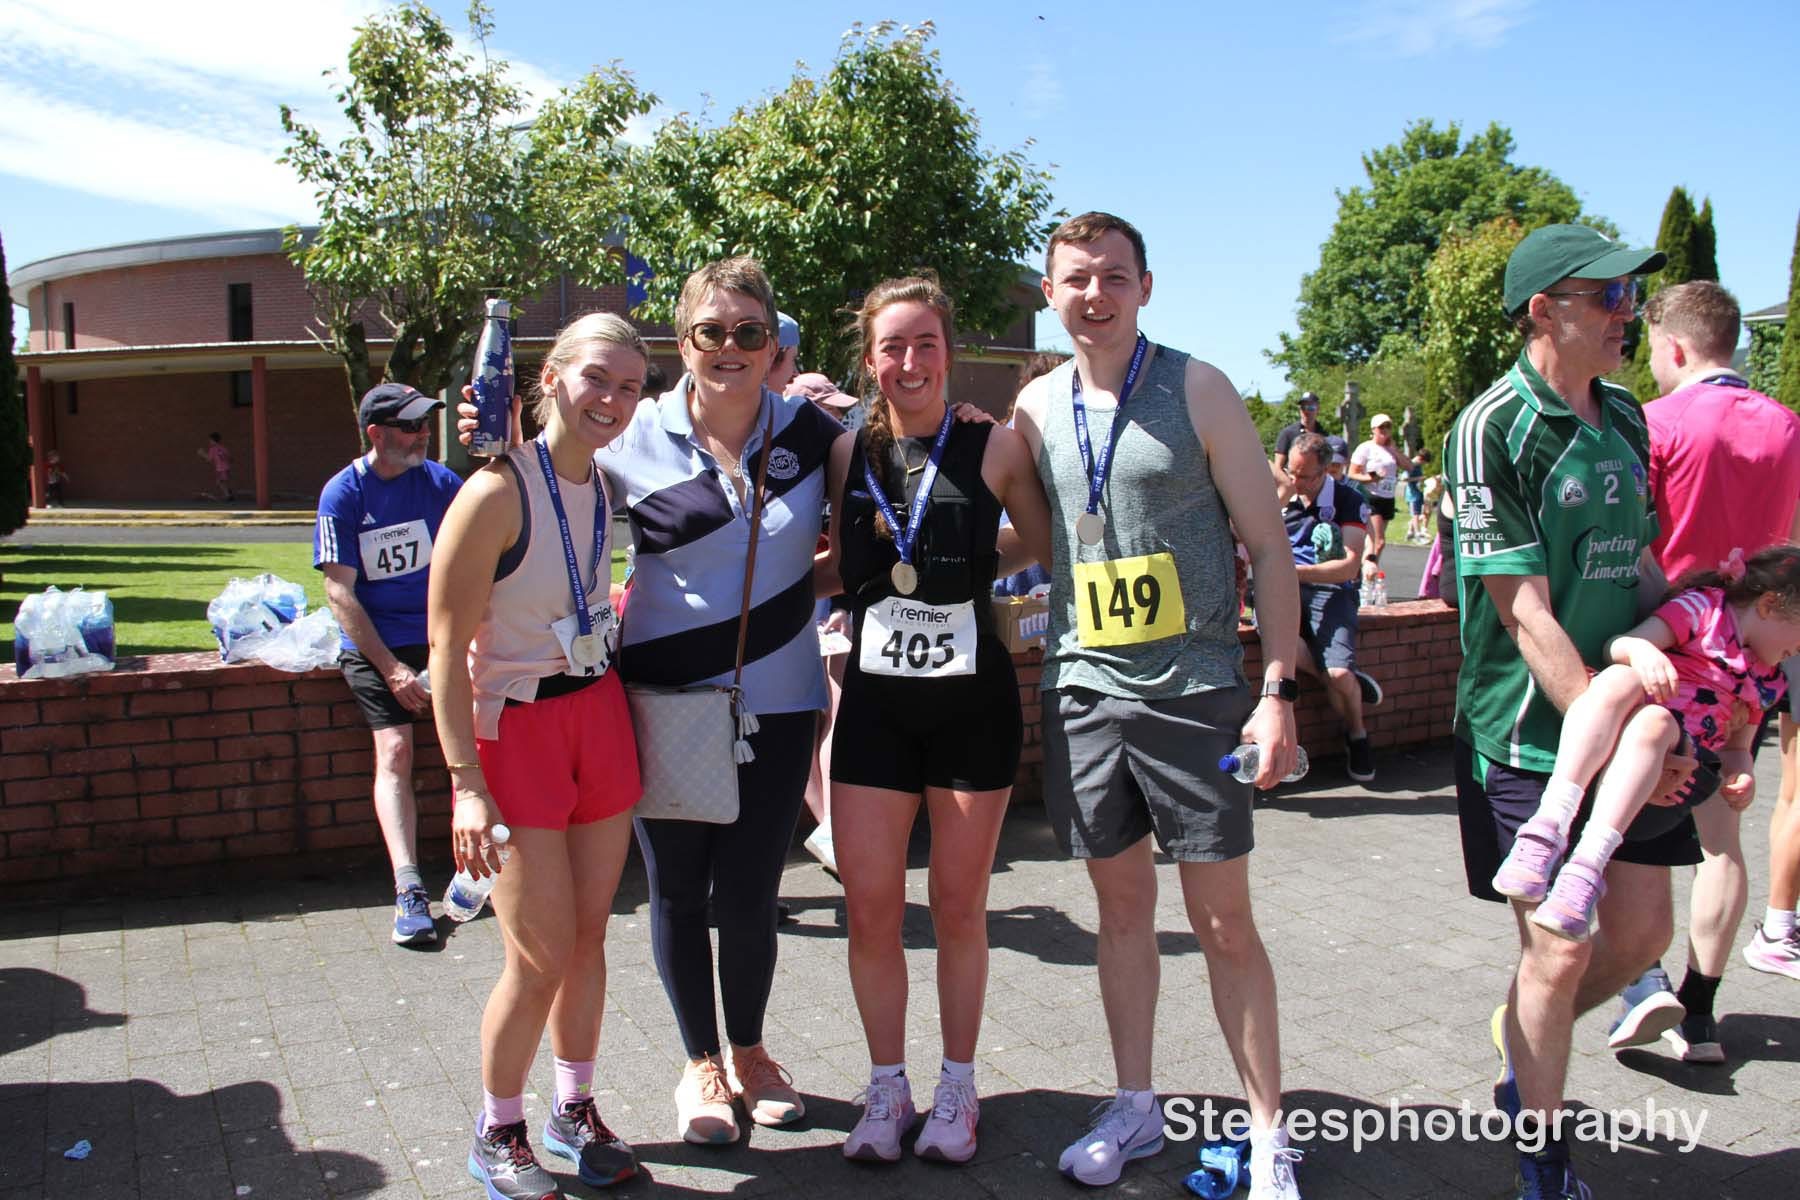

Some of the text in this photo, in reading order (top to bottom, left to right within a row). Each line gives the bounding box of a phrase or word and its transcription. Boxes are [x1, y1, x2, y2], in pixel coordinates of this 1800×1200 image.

[540, 450, 554, 480] AGAINST
[1098, 448, 1108, 476] CANCER
[548, 480, 558, 494] RUN
[1604, 474, 1619, 504] 2
[883, 507, 898, 530] CANCER
[906, 501, 922, 543] RUN AGAINST
[377, 540, 420, 573] 457
[564, 535, 575, 564] CANCER
[570, 564, 582, 594] AGAINST
[576, 594, 584, 610] RUN
[890, 600, 952, 623] Premier
[1087, 574, 1161, 631] 149
[881, 630, 955, 670] 405
